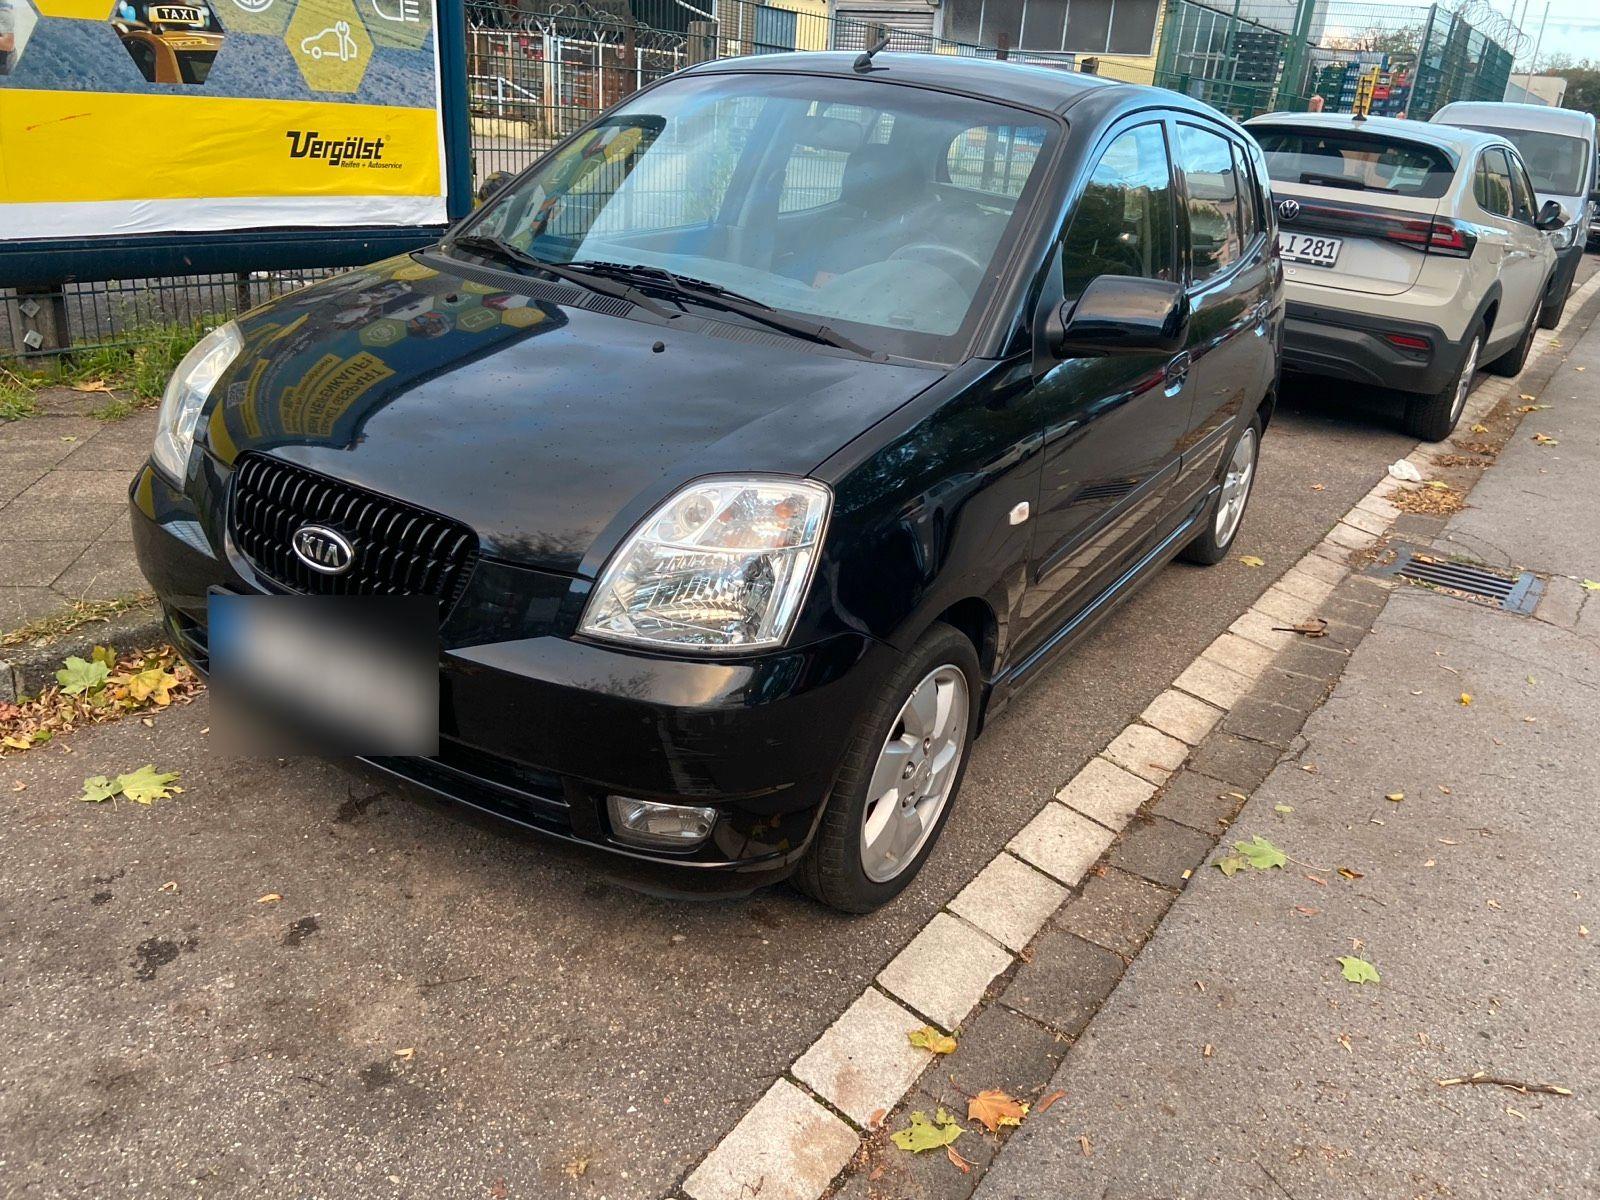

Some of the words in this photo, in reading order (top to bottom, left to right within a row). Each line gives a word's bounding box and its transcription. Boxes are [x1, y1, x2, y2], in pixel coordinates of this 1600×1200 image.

[162, 9, 194, 19] TAXI
[286, 131, 384, 166] Vergölst
[341, 160, 359, 168] Reifen
[368, 161, 402, 169] Autoservice
[1300, 238, 1336, 259] 281
[301, 533, 339, 566] KIA
